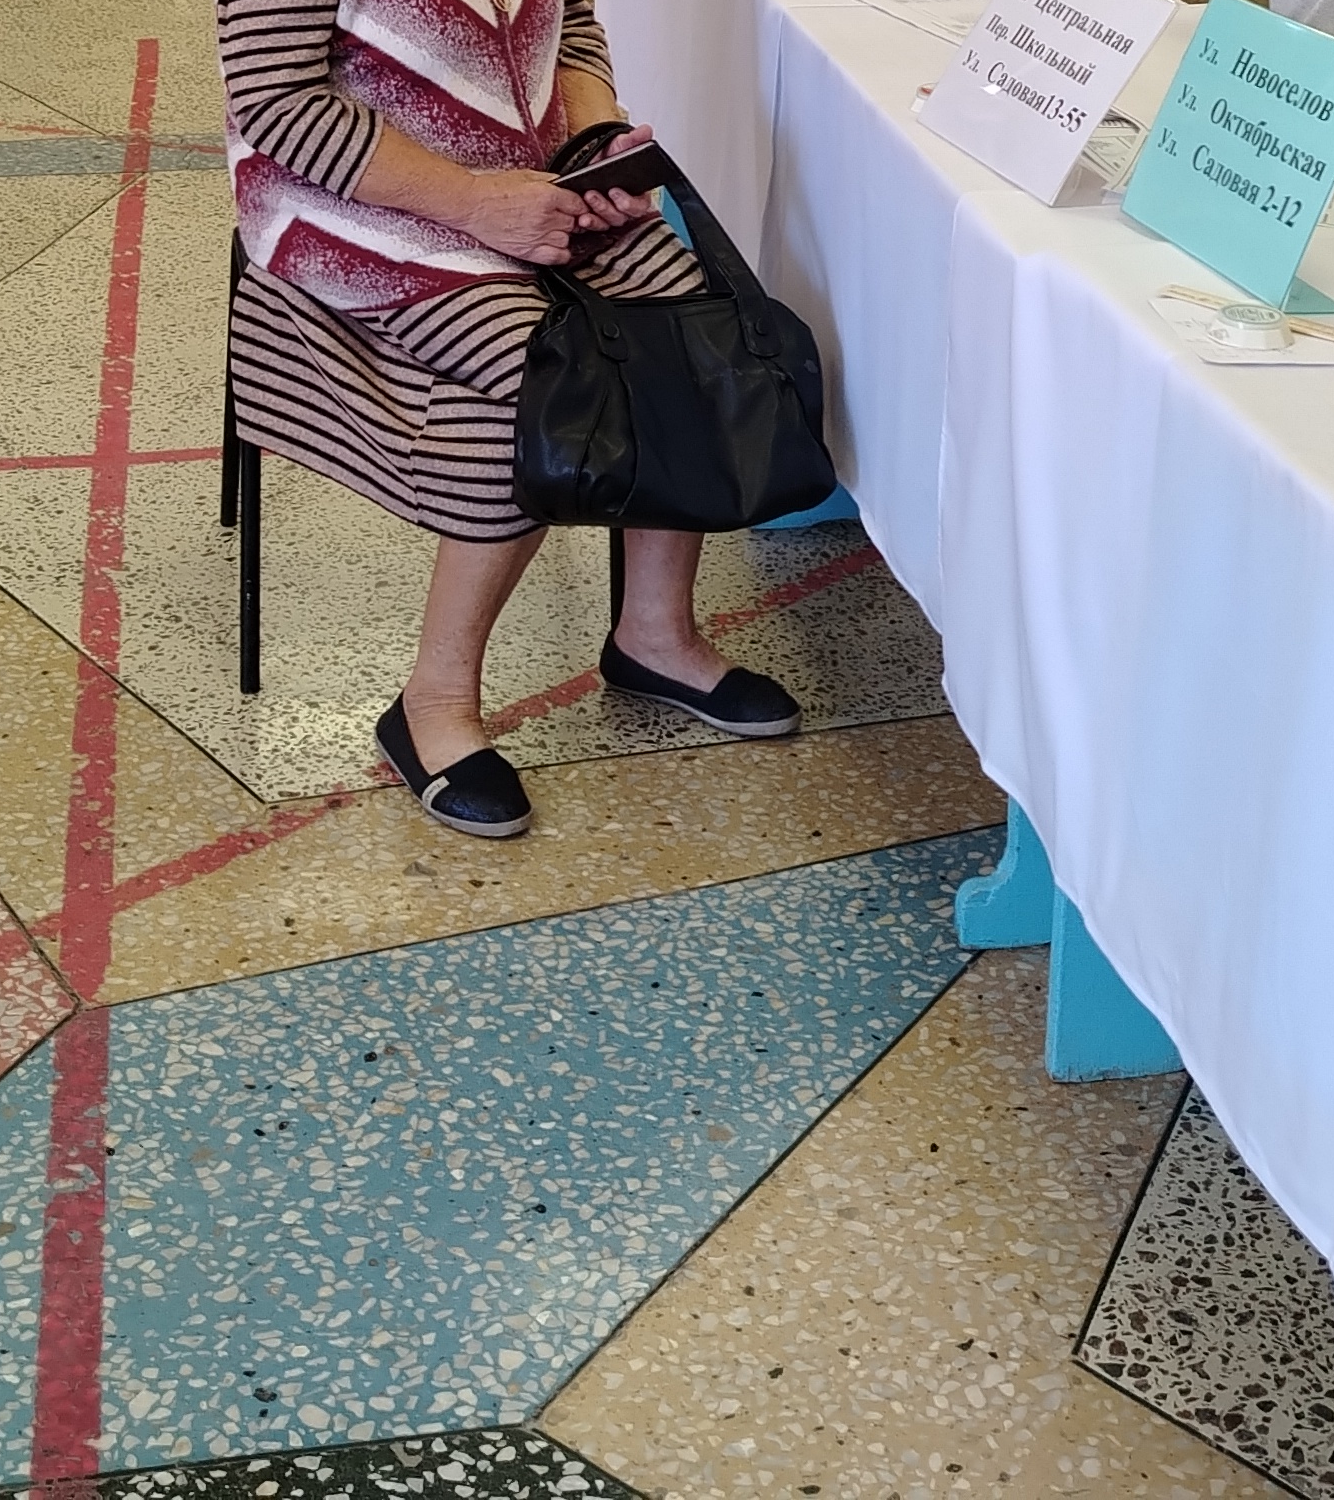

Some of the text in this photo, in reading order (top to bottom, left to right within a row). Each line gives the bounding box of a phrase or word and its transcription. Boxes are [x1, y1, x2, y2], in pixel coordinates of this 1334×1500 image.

[985, 14, 1097, 86] Пер. Школьный
[1198, 37, 1334, 122] Ул. Новоселов
[1157, 127, 1178, 158] Ул.
[1192, 145, 1261, 206] Садовая
[1260, 185, 1303, 228] 2-12
[1177, 83, 1327, 182] Ул. Октябрьская
